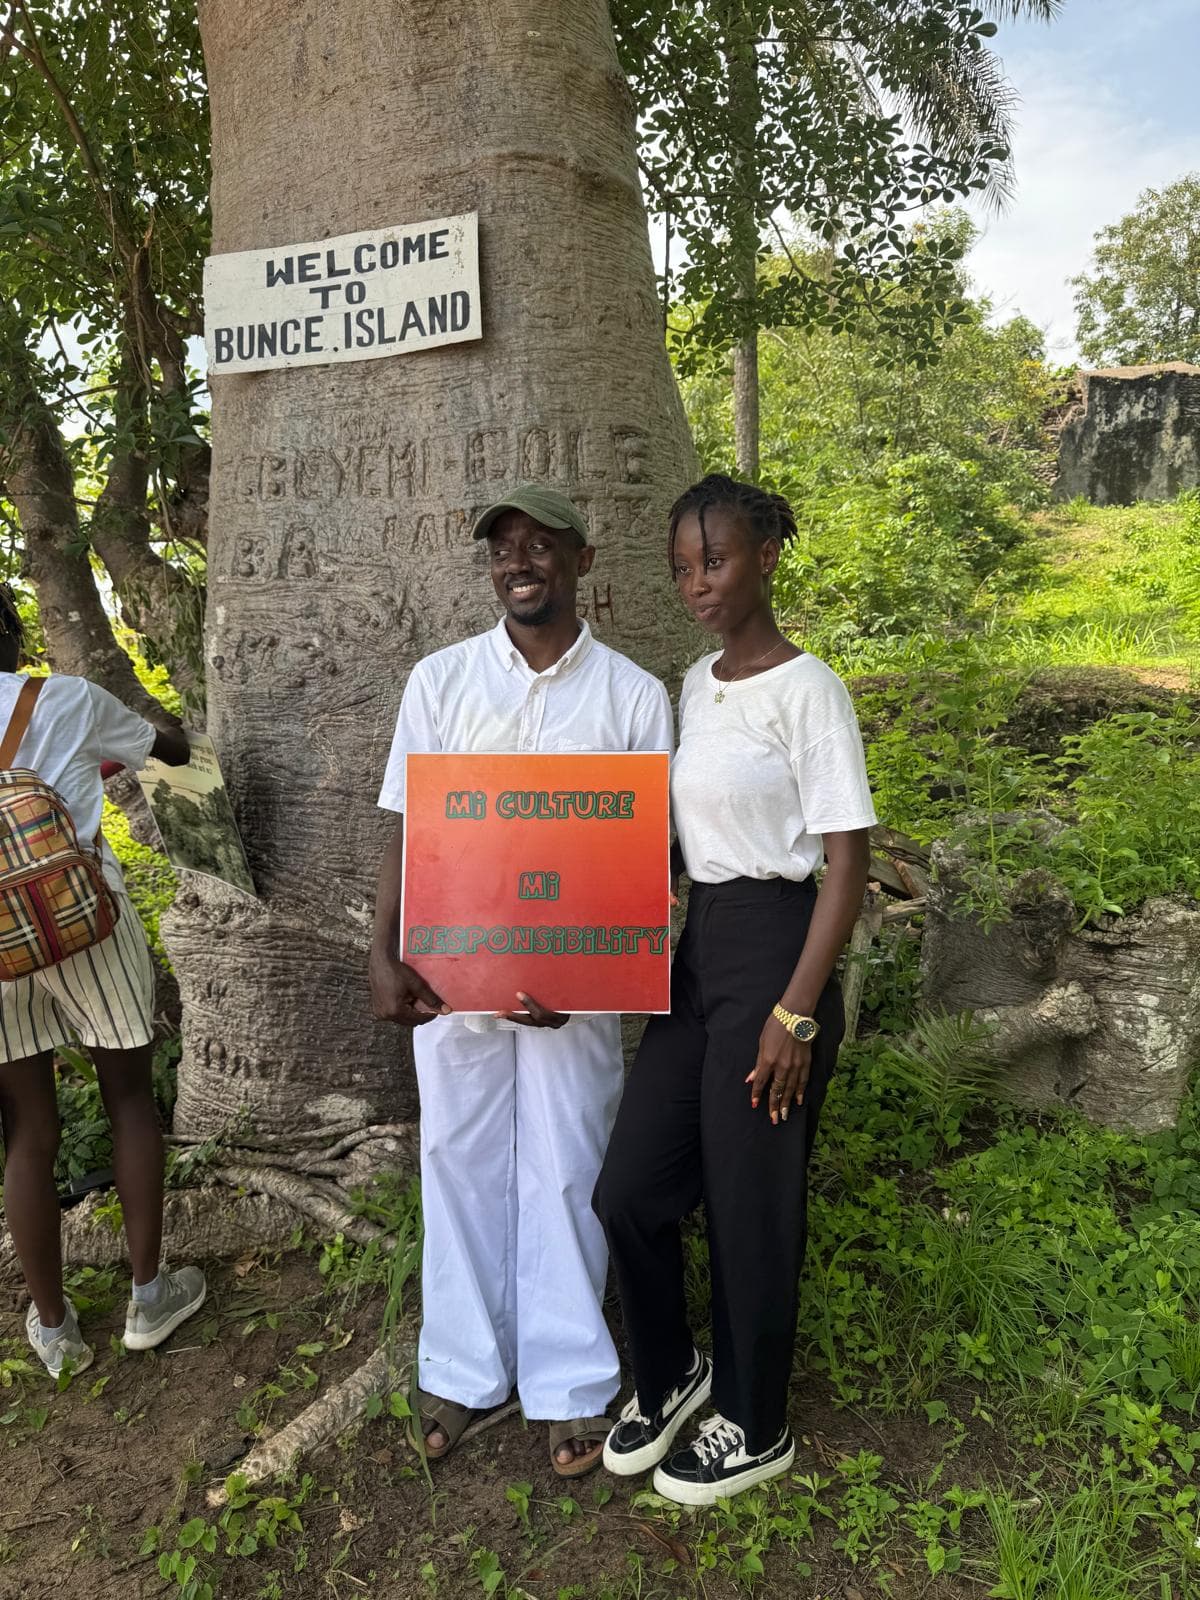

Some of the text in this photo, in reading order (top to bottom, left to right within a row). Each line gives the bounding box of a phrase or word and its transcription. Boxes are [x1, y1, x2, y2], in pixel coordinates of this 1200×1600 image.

[266, 229, 449, 287] WELCOME
[309, 281, 366, 309] TO
[214, 290, 471, 364] BUNCE ISLAND
[496, 791, 635, 820] CULTURE
